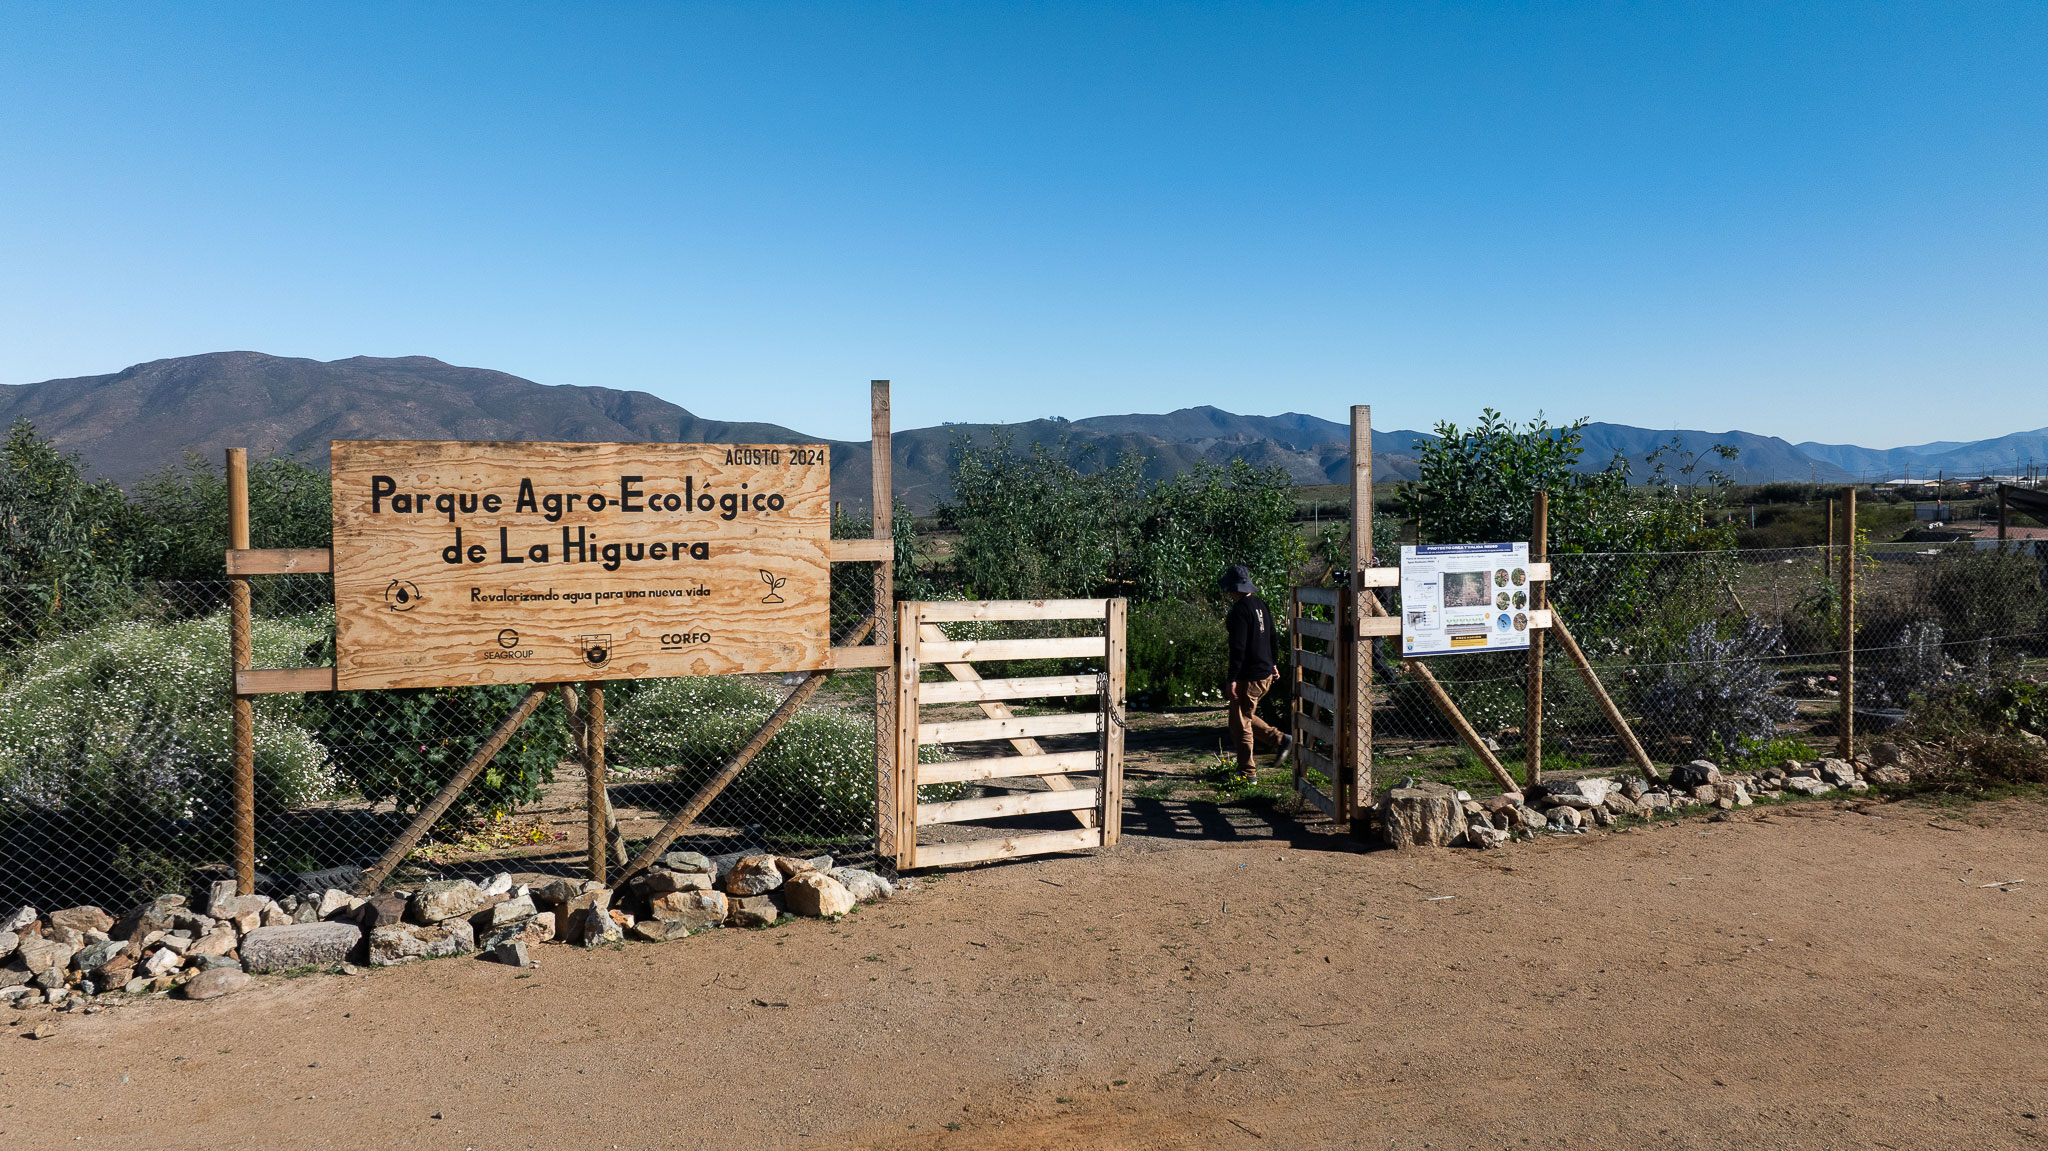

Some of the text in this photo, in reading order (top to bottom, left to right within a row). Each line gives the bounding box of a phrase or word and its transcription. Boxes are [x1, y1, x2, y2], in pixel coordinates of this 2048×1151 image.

[725, 449, 825, 466] AGOSTO 2024
[371, 475, 785, 523] Parque Agro-Ecológico
[441, 525, 710, 572] de La Higuera
[470, 583, 711, 605] Revalorizando agua para una nueva vida
[660, 632, 711, 645] CORFO
[483, 649, 534, 661] SEAGROUP
